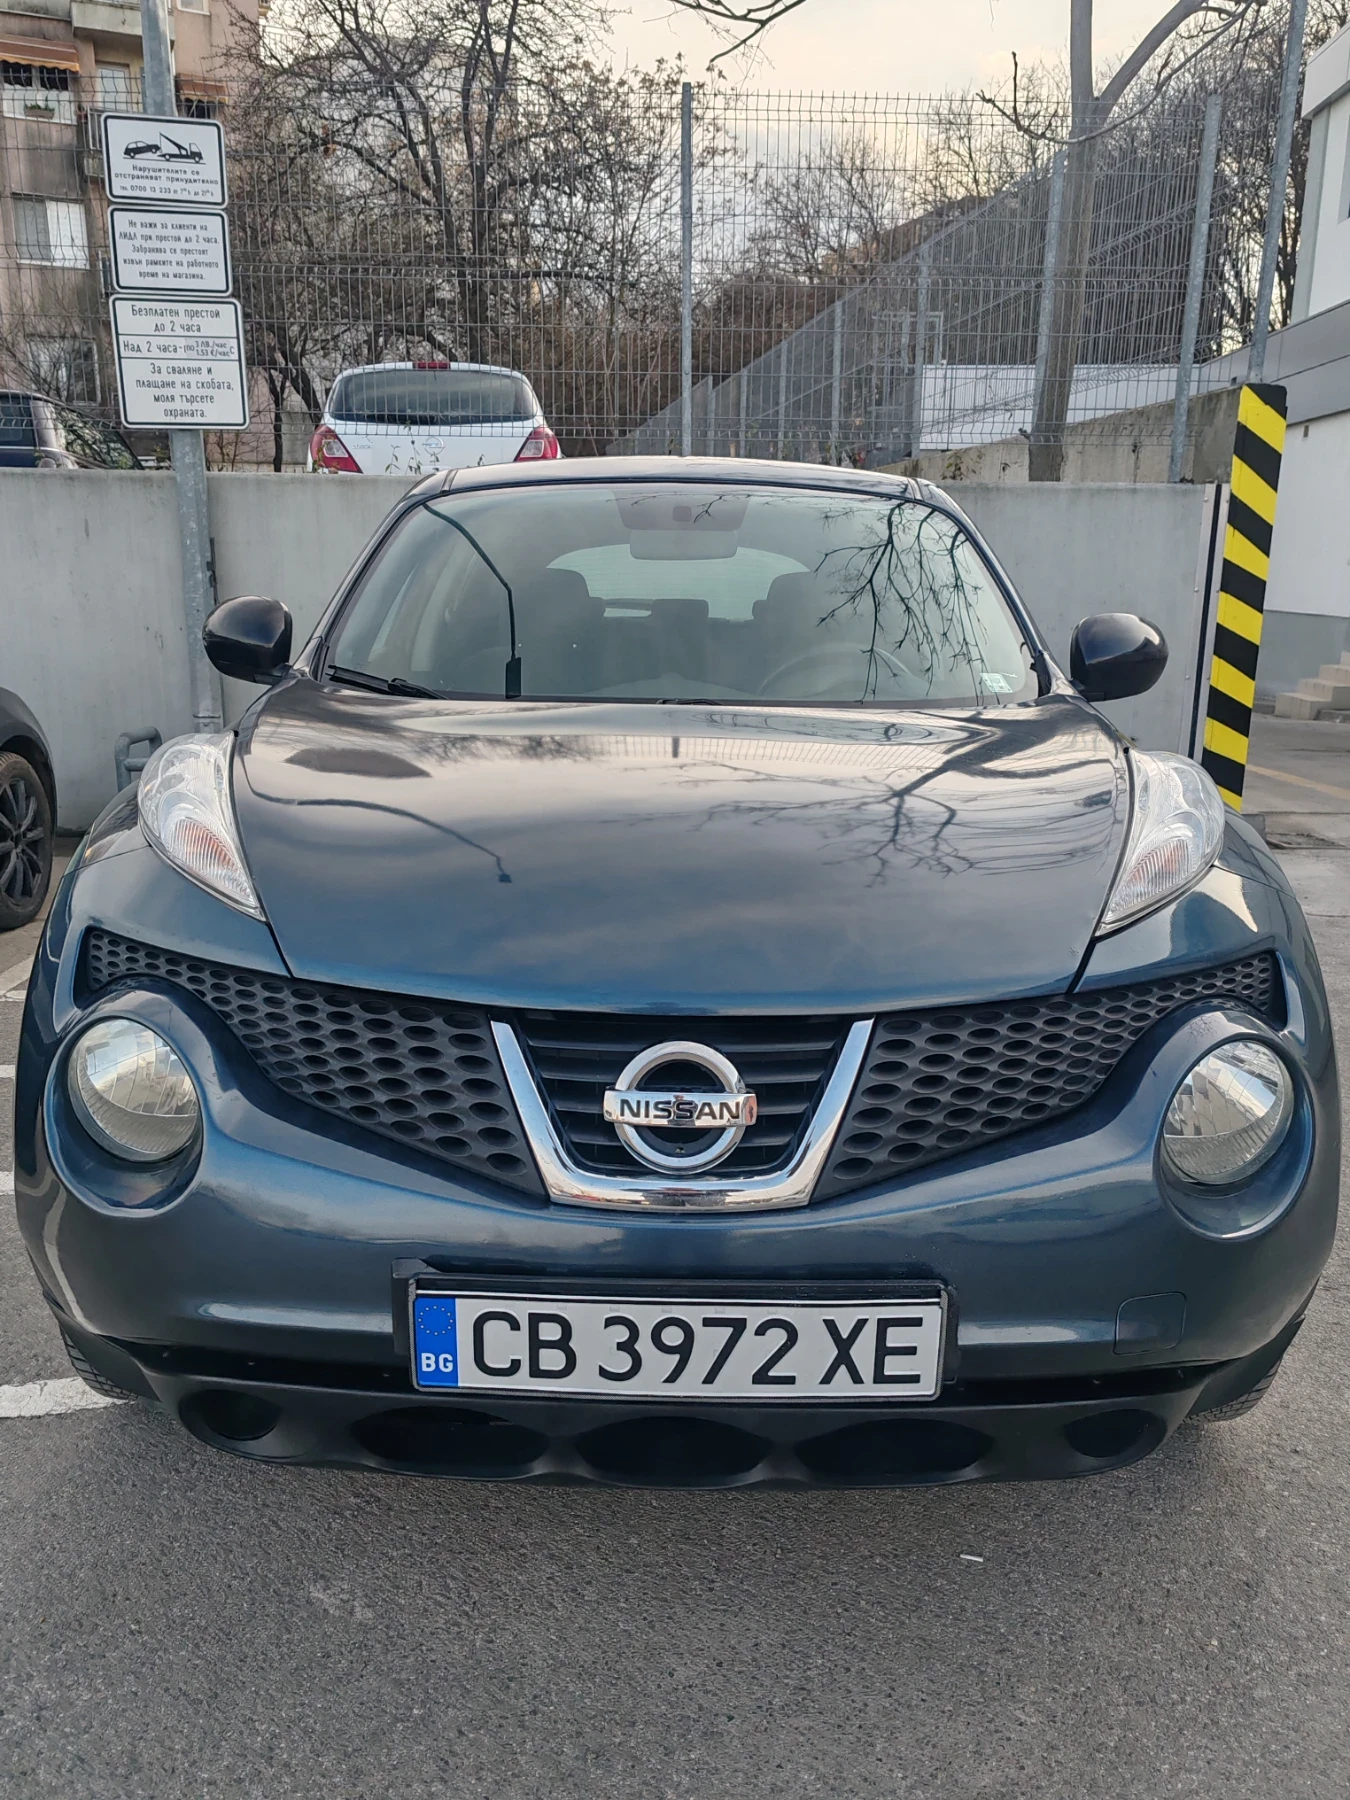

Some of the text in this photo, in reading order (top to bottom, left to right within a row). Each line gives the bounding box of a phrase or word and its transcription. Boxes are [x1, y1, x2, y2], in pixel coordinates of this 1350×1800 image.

[132, 164, 188, 175] Нарушителите
[166, 176, 219, 185] принудително
[128, 219, 137, 228] Не
[140, 221, 157, 229] важи
[171, 223, 197, 231] клиенти
[119, 231, 138, 241] ЛИДЛ
[141, 234, 153, 243] при
[156, 234, 182, 243] престой
[196, 235, 200, 244] 2
[132, 244, 208, 257] Забранява се престоят
[146, 259, 173, 267] рамките
[187, 259, 219, 270] работното
[139, 271, 159, 279] време
[172, 272, 206, 280] магазина.
[131, 304, 220, 320] Безплатен престой
[154, 320, 201, 333] до 2 часа
[123, 340, 142, 353] Над
[146, 341, 152, 353] 2
[150, 363, 212, 375] За сваляне и
[136, 378, 234, 391] плащане на скобата,
[153, 394, 214, 406] моля търсете
[164, 408, 207, 419] охраната.
[619, 1098, 740, 1120] NISSAN
[472, 1310, 923, 1386] CB 3972 XE
[421, 1352, 454, 1373] BG
